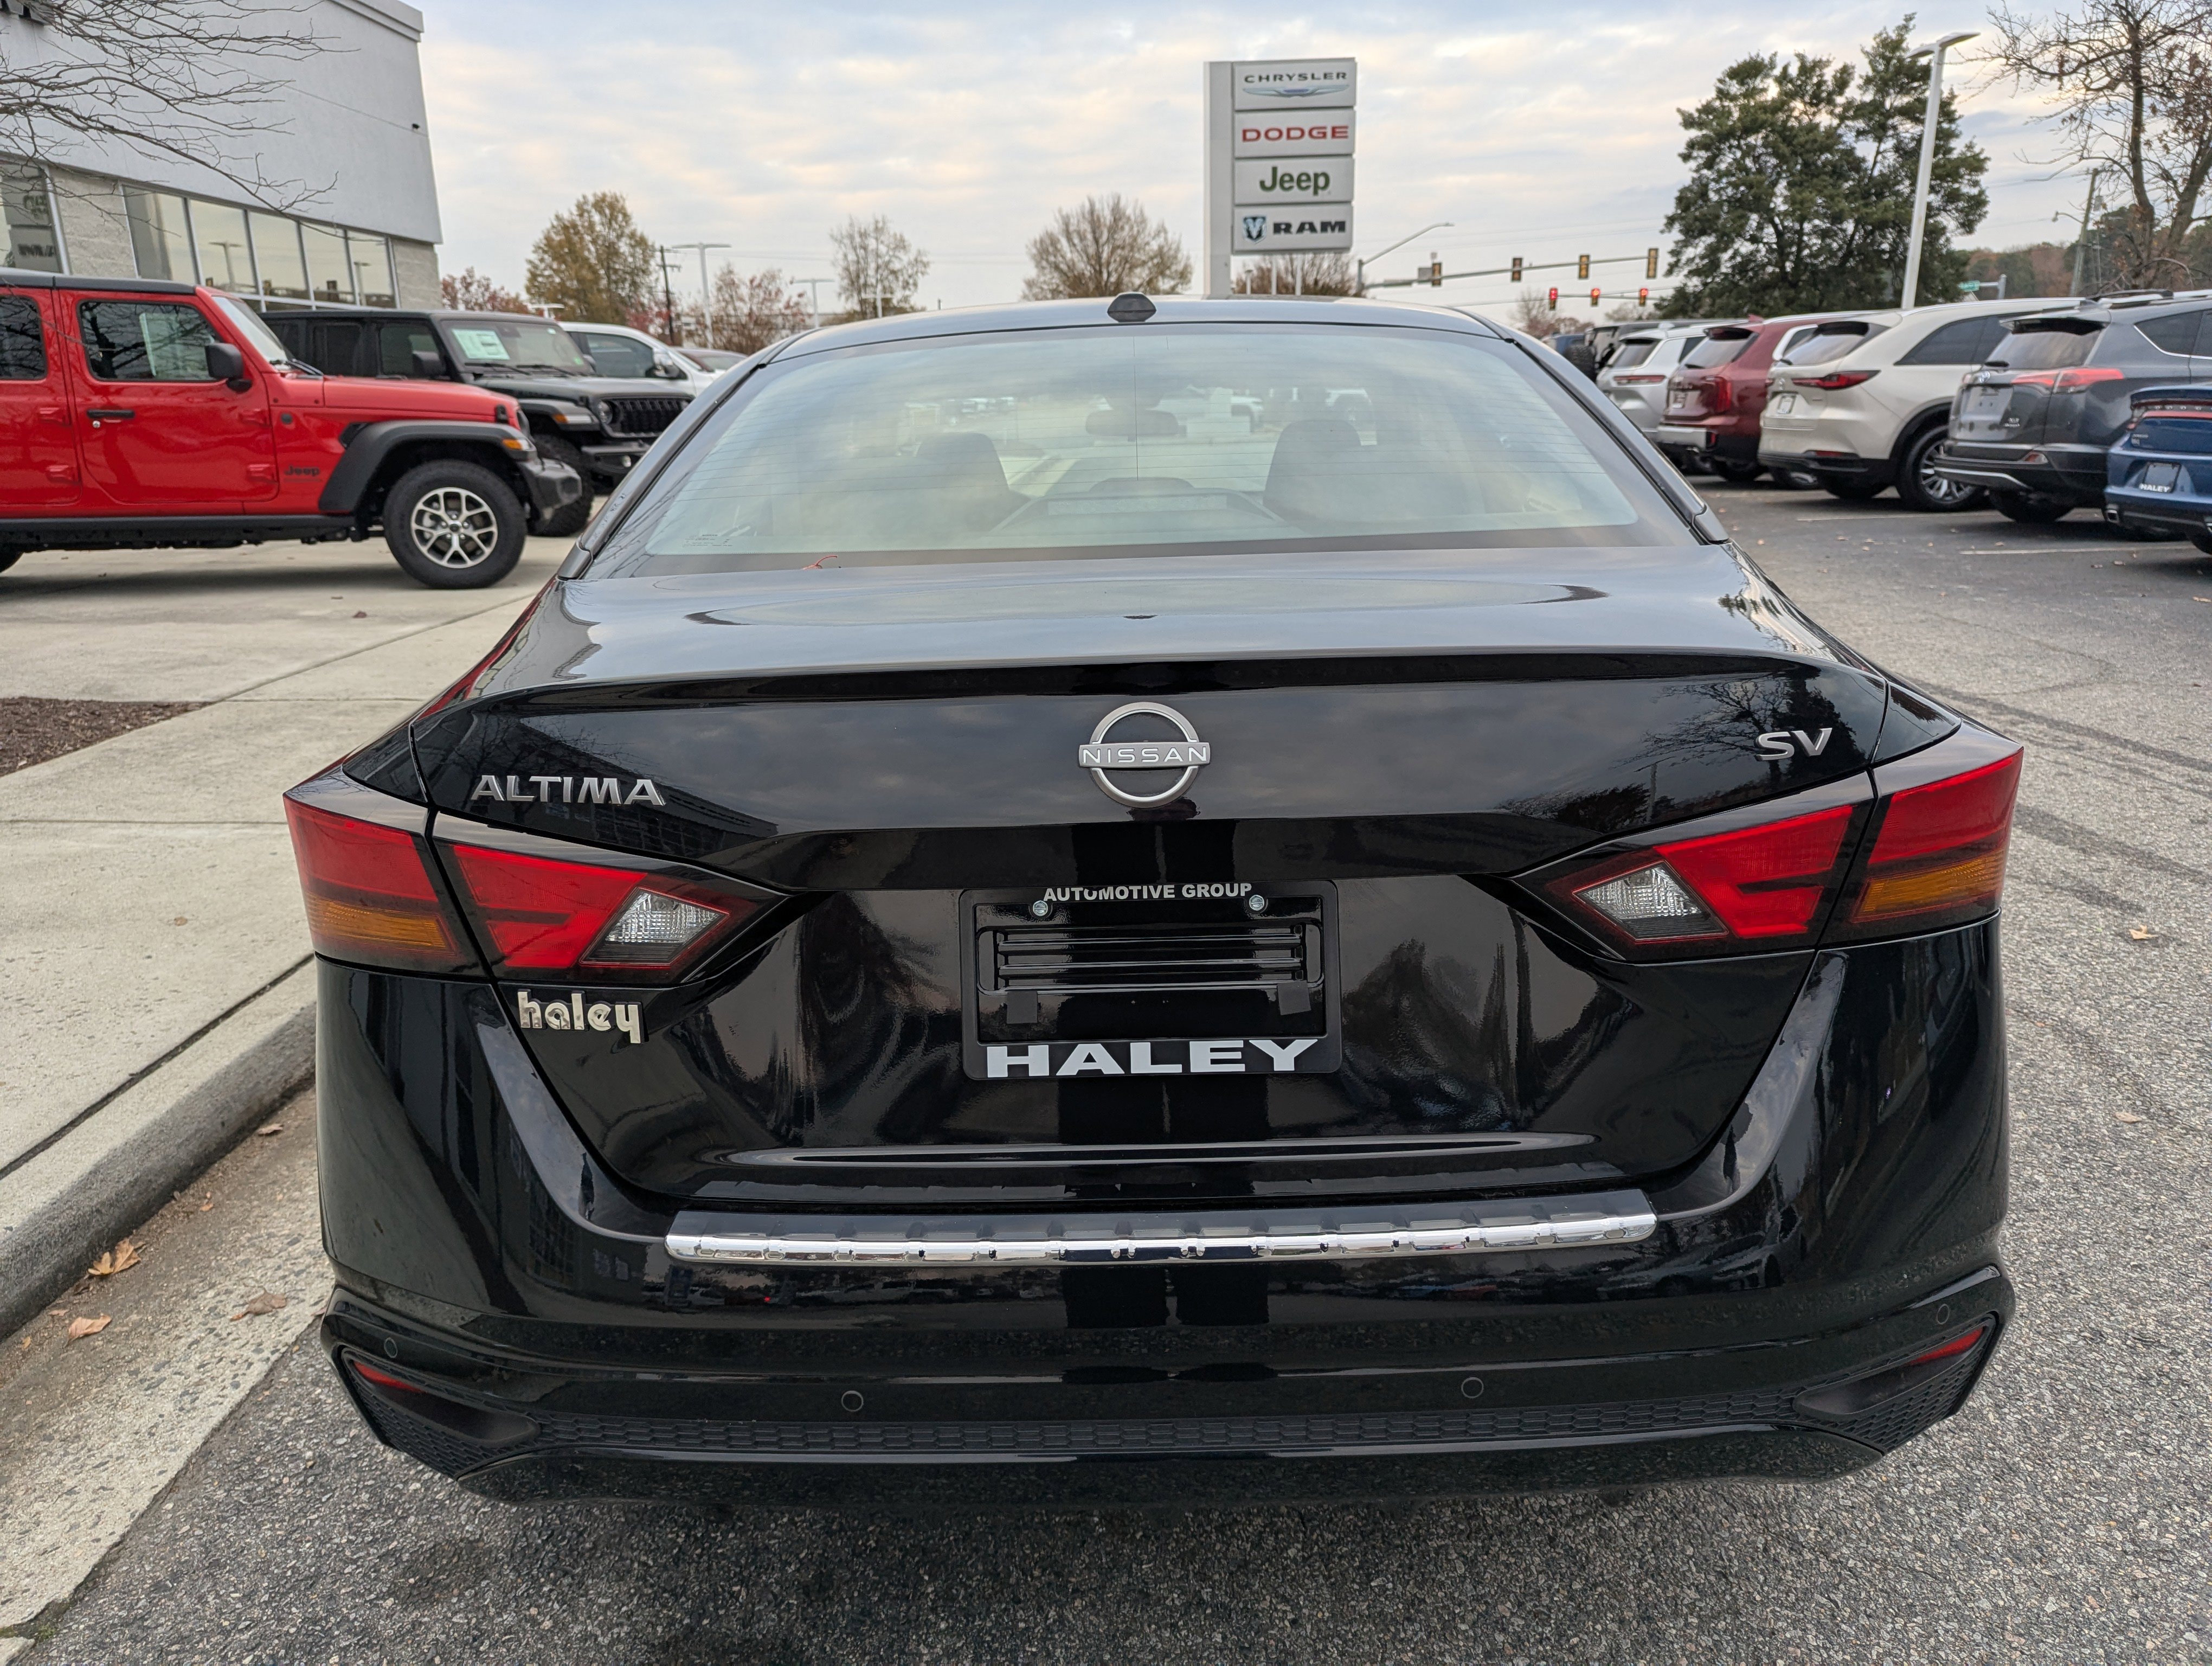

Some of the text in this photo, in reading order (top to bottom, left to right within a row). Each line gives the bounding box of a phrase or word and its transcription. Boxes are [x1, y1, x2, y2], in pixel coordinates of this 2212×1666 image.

[1244, 72, 1347, 84] CHRYSLER
[1242, 125, 1349, 143] DODGE
[1259, 165, 1330, 196] Jeep
[1272, 220, 1347, 235] RAM
[284, 464, 320, 477] Jeep
[2139, 483, 2170, 492] HALEY
[1754, 727, 1833, 761] SV
[1082, 746, 1207, 764] NISSAN
[471, 774, 666, 806] ALTIMA
[1043, 883, 1252, 901] AUTOMOTIVE GROUP
[517, 989, 643, 1045] haley
[986, 1039, 1318, 1078] HALEY
